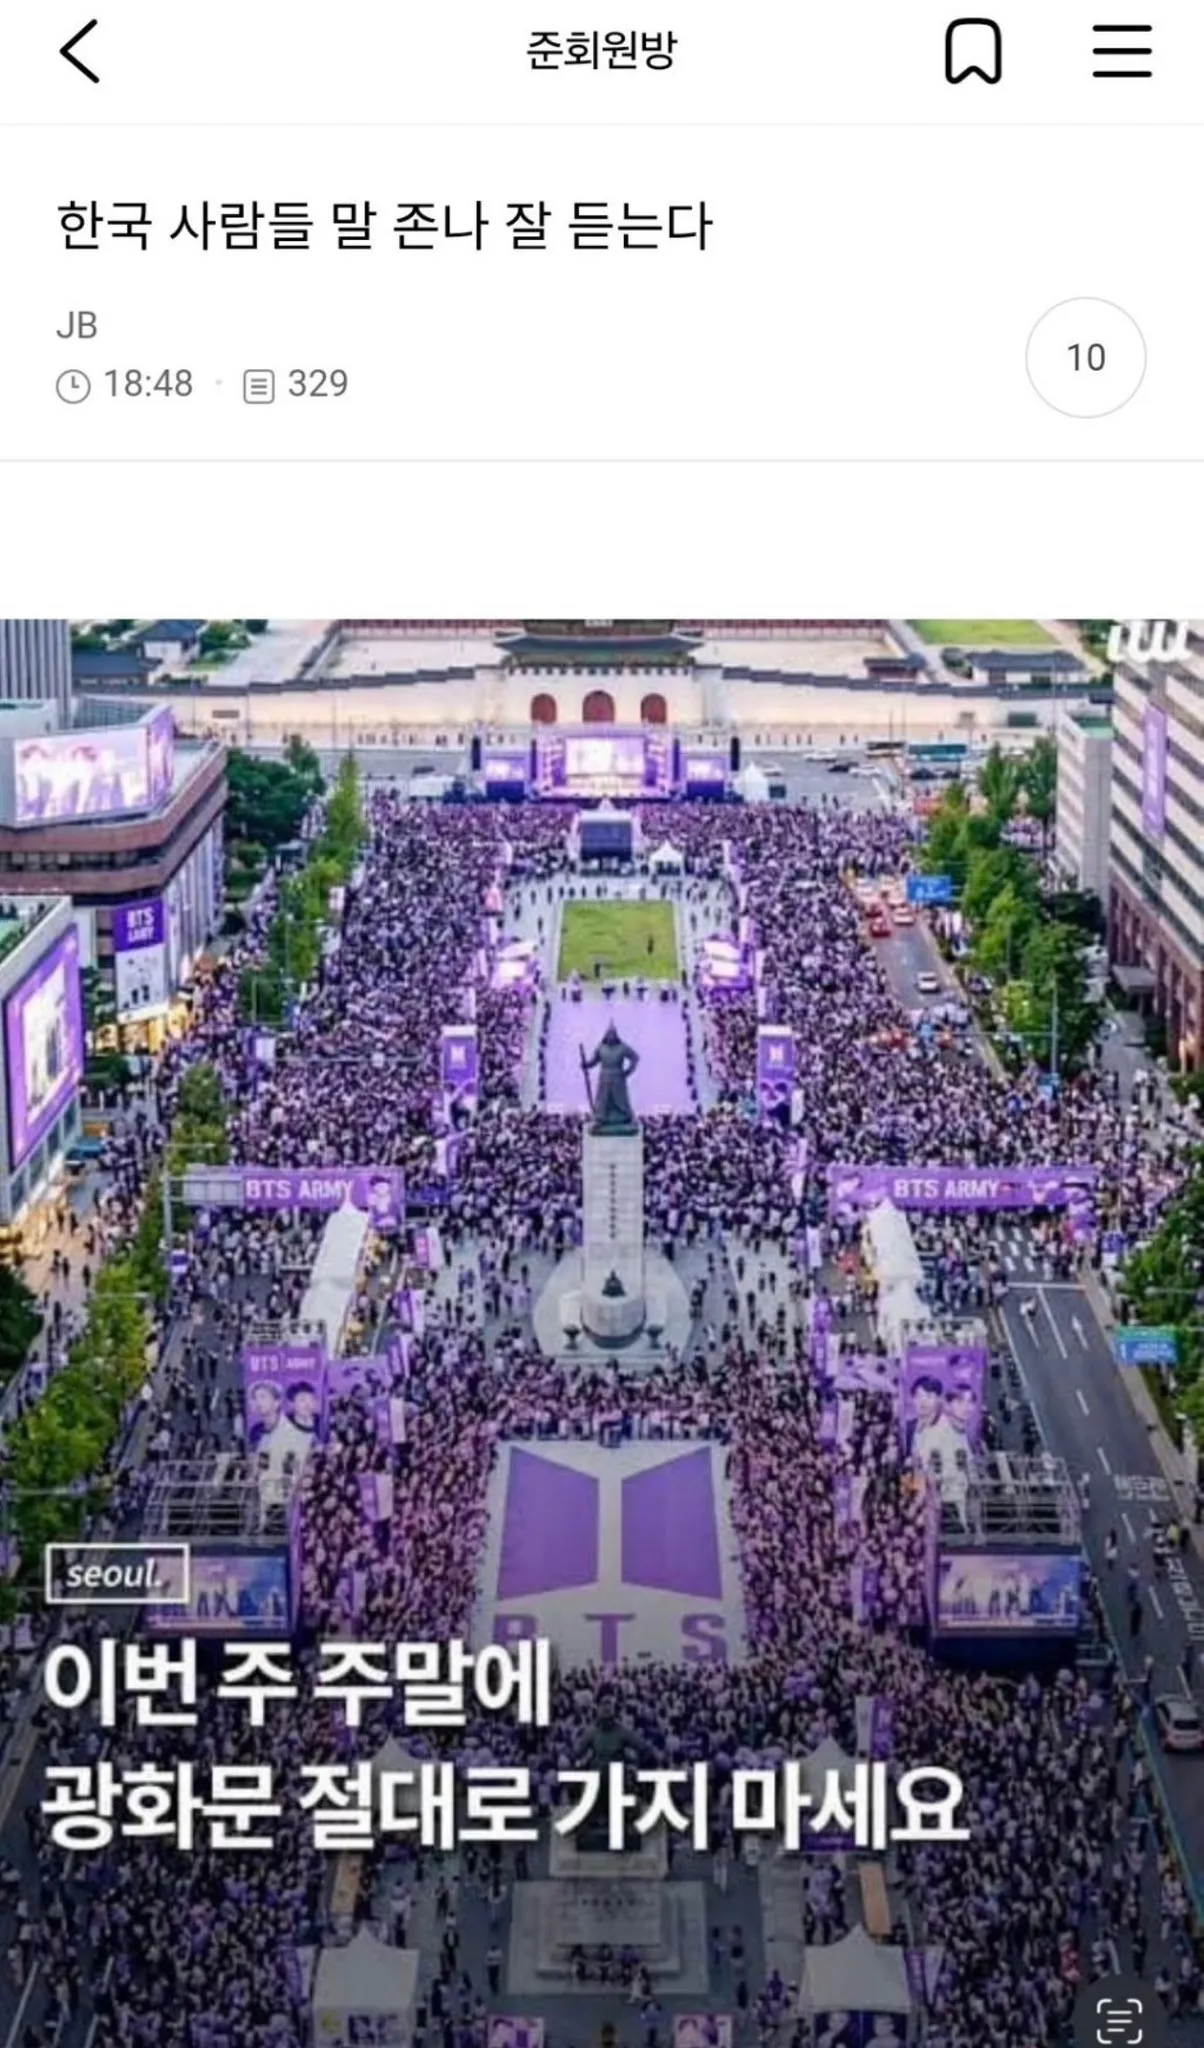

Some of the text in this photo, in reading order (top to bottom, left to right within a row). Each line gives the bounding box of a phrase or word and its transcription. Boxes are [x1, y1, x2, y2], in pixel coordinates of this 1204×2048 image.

[526, 30, 679, 71] 준회원방
[57, 200, 714, 251] 한국 사람들 말 존나 잘 듣는다
[56, 310, 98, 339] JB
[1067, 343, 1106, 372] 10
[104, 368, 193, 397] 18:48
[288, 368, 348, 397] 329
[246, 1179, 355, 1200] BTS ARMY
[893, 1178, 1000, 1199] BTS ARMY
